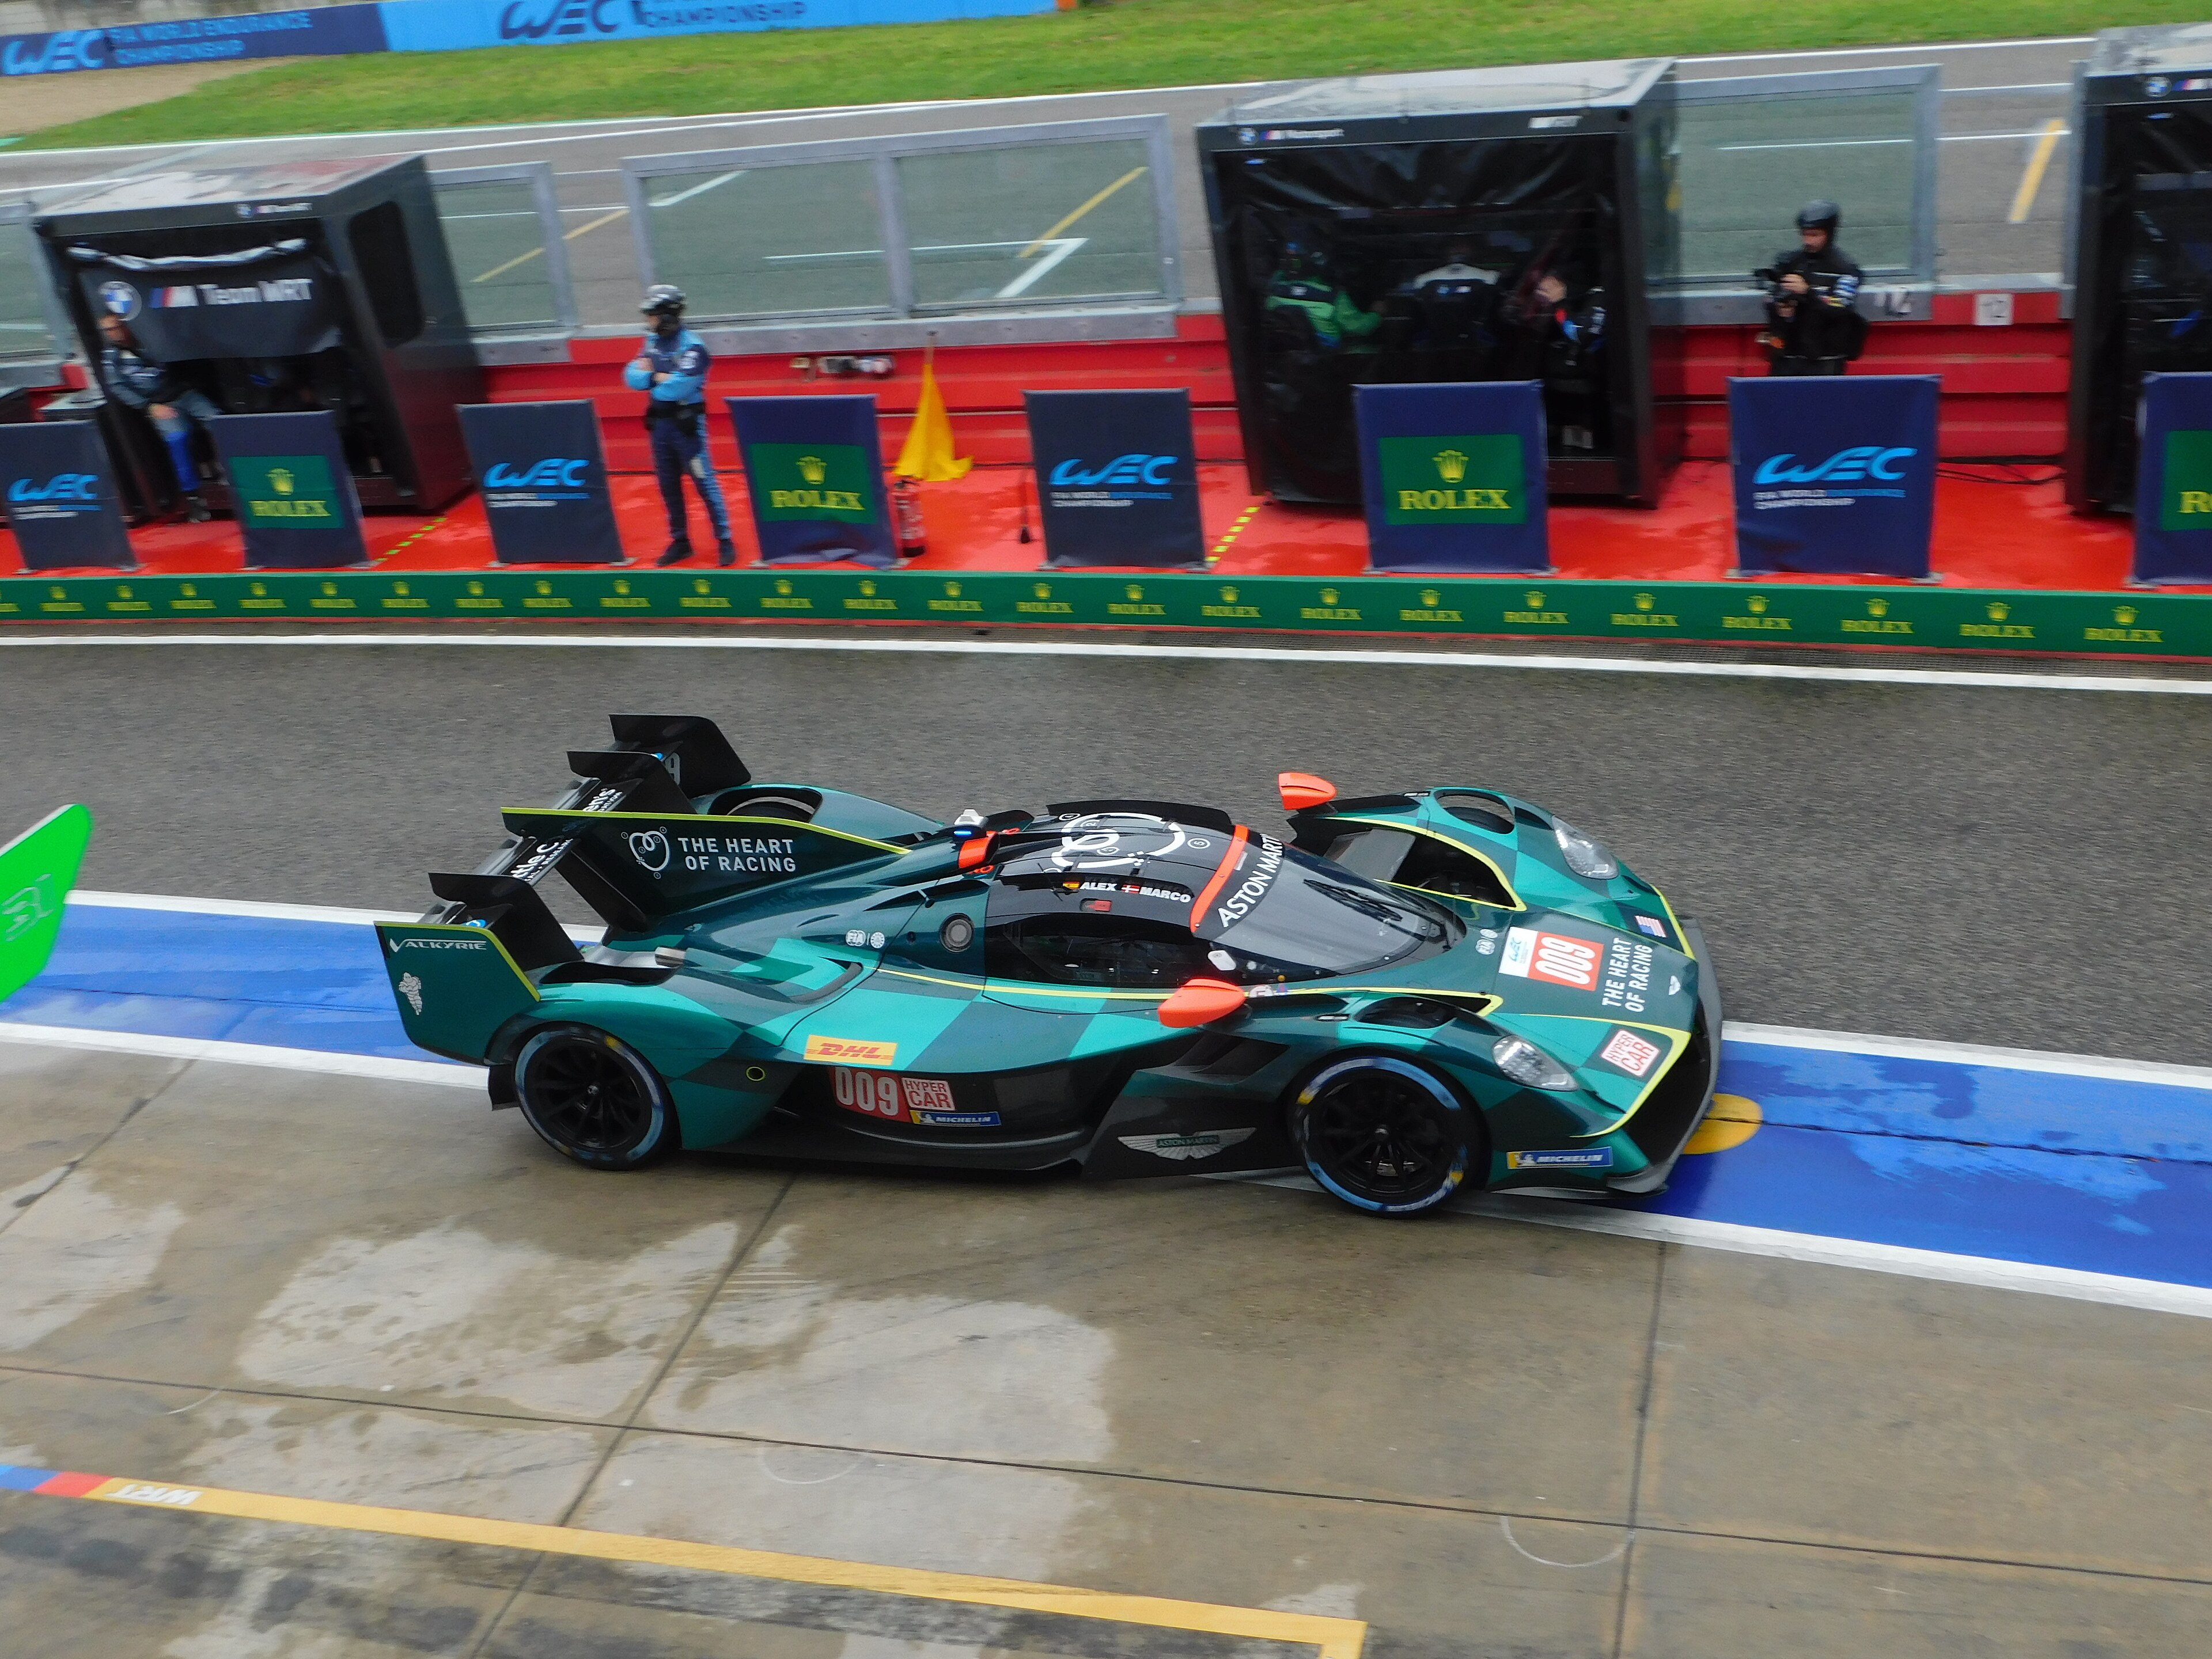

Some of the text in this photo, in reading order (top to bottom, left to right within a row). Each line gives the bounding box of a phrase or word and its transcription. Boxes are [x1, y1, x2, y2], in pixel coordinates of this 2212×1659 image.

[2, 31, 104, 75] WEC
[483, 459, 590, 487] WEC
[1048, 453, 1179, 486] WEC
[1752, 446, 1918, 484] WEC
[6, 474, 99, 500] WEC
[770, 490, 865, 510] ROLEX
[1398, 489, 1512, 510] ROLEX
[677, 838, 794, 854] THE HEART
[685, 856, 796, 872] OF RACING
[1080, 882, 1191, 903] ALEX MARCO
[1218, 833, 1283, 927] ASTON MARTI
[389, 938, 487, 953] VALKYRIE
[1535, 937, 1596, 984] 009
[1601, 937, 1632, 1007] THE HEART
[1624, 944, 1653, 1012] OF RACING
[818, 1043, 880, 1059] DHL
[1605, 1034, 1635, 1062] HYPER
[1621, 1041, 1654, 1071] CAR
[835, 1066, 899, 1116] 009
[904, 1080, 946, 1093] HYPER
[908, 1090, 951, 1108] CAR
